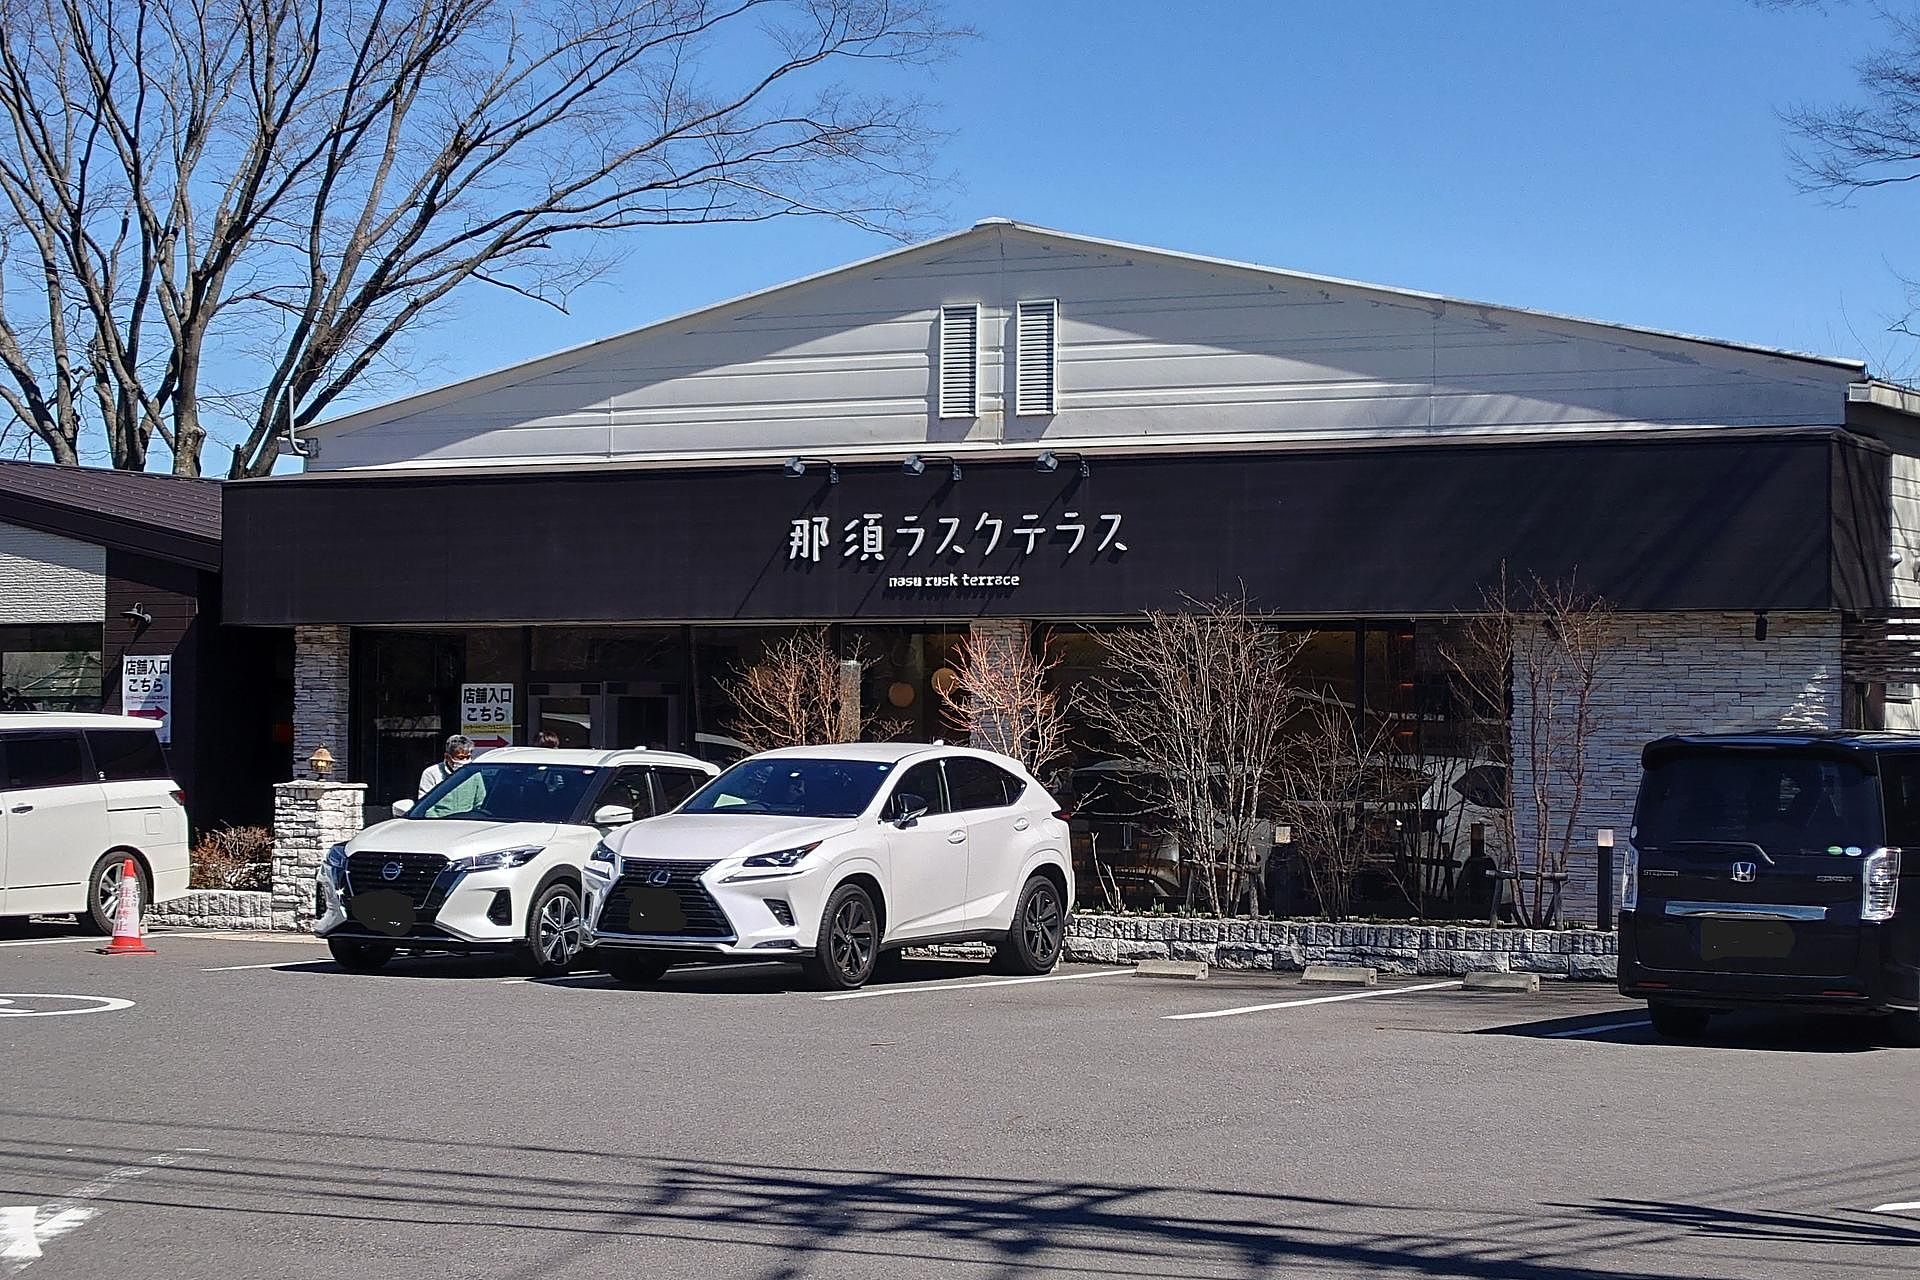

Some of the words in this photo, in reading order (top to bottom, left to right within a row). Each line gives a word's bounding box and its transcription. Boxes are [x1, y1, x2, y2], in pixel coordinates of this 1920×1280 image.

[789, 512, 1128, 562] 那須ラスクテラス
[889, 576, 922, 587] nasu
[924, 573, 958, 587] rusk
[961, 573, 1020, 586] terrace
[125, 660, 170, 675] 店舗入口
[128, 678, 164, 692] こちら
[463, 688, 512, 704] 店舗入口
[467, 706, 505, 721] こちら
